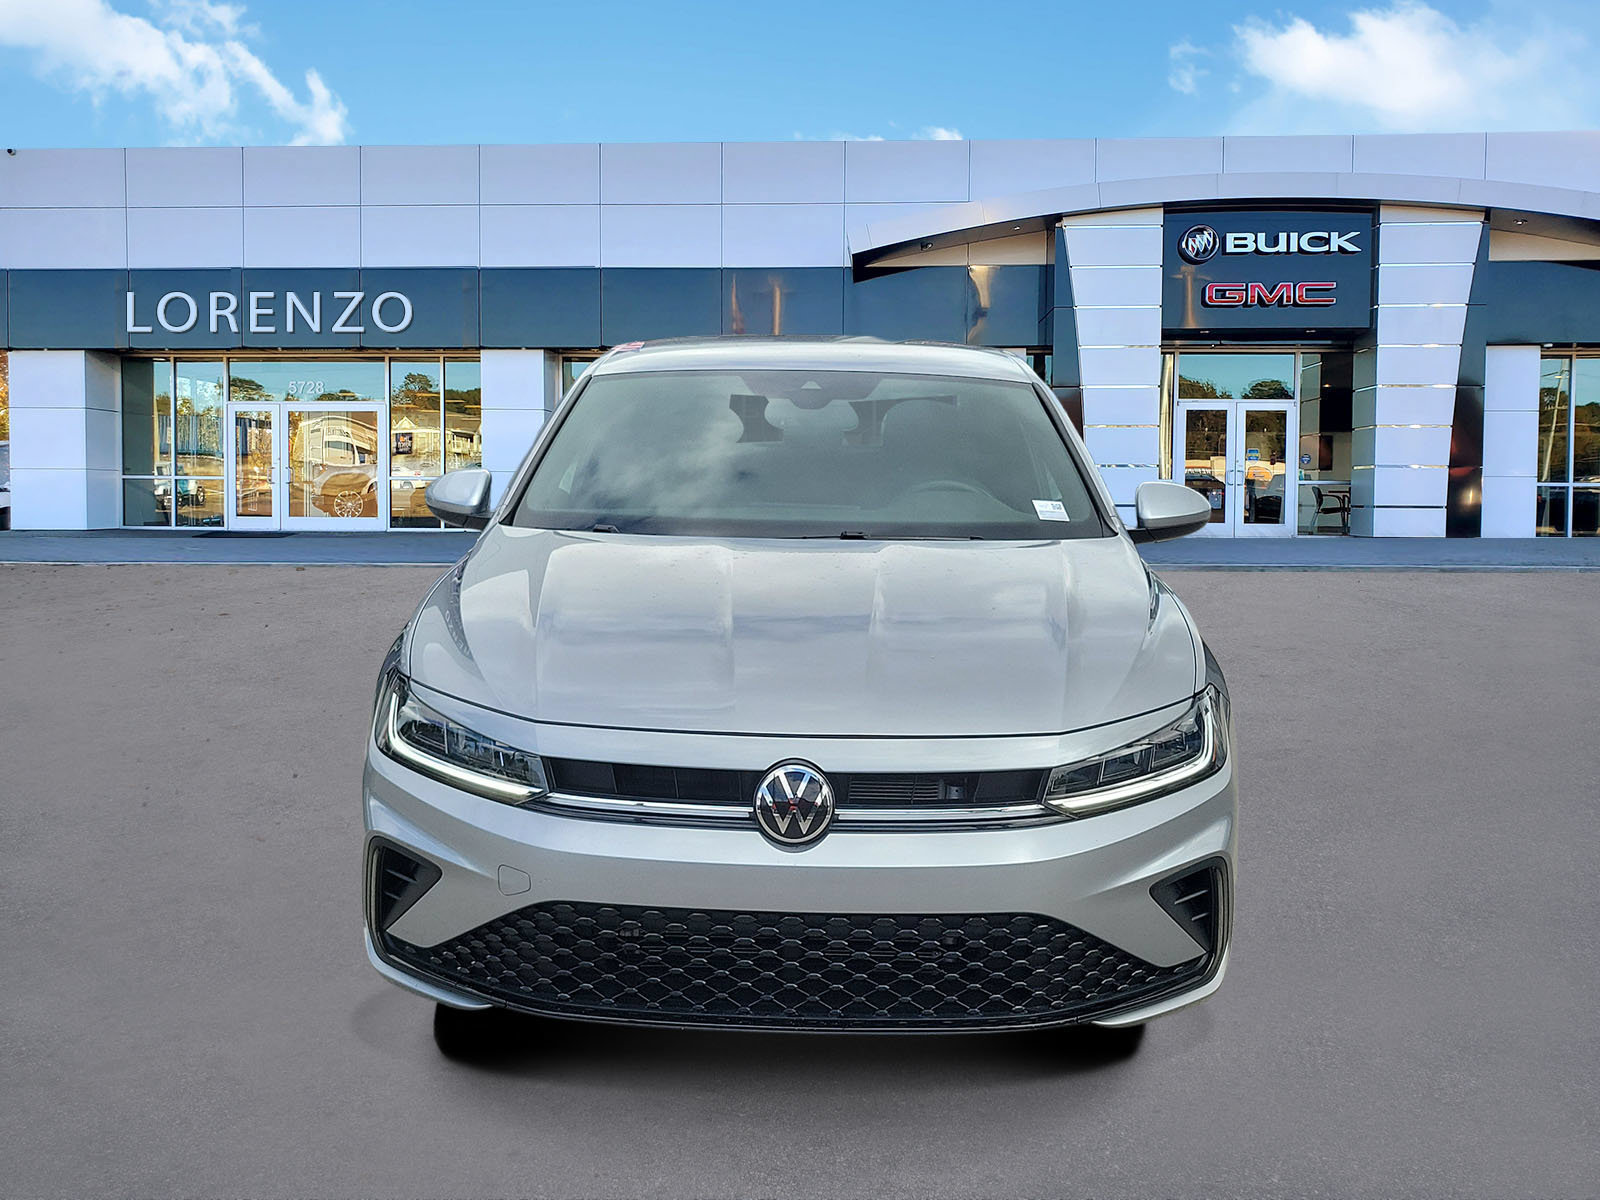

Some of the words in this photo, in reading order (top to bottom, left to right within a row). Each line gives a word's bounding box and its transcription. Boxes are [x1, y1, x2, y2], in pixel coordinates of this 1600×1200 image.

[1225, 231, 1362, 253] BUICK
[1204, 281, 1337, 305] GMC
[126, 291, 413, 334] LORENZO
[288, 380, 325, 395] 5728
[759, 767, 829, 837] VW
